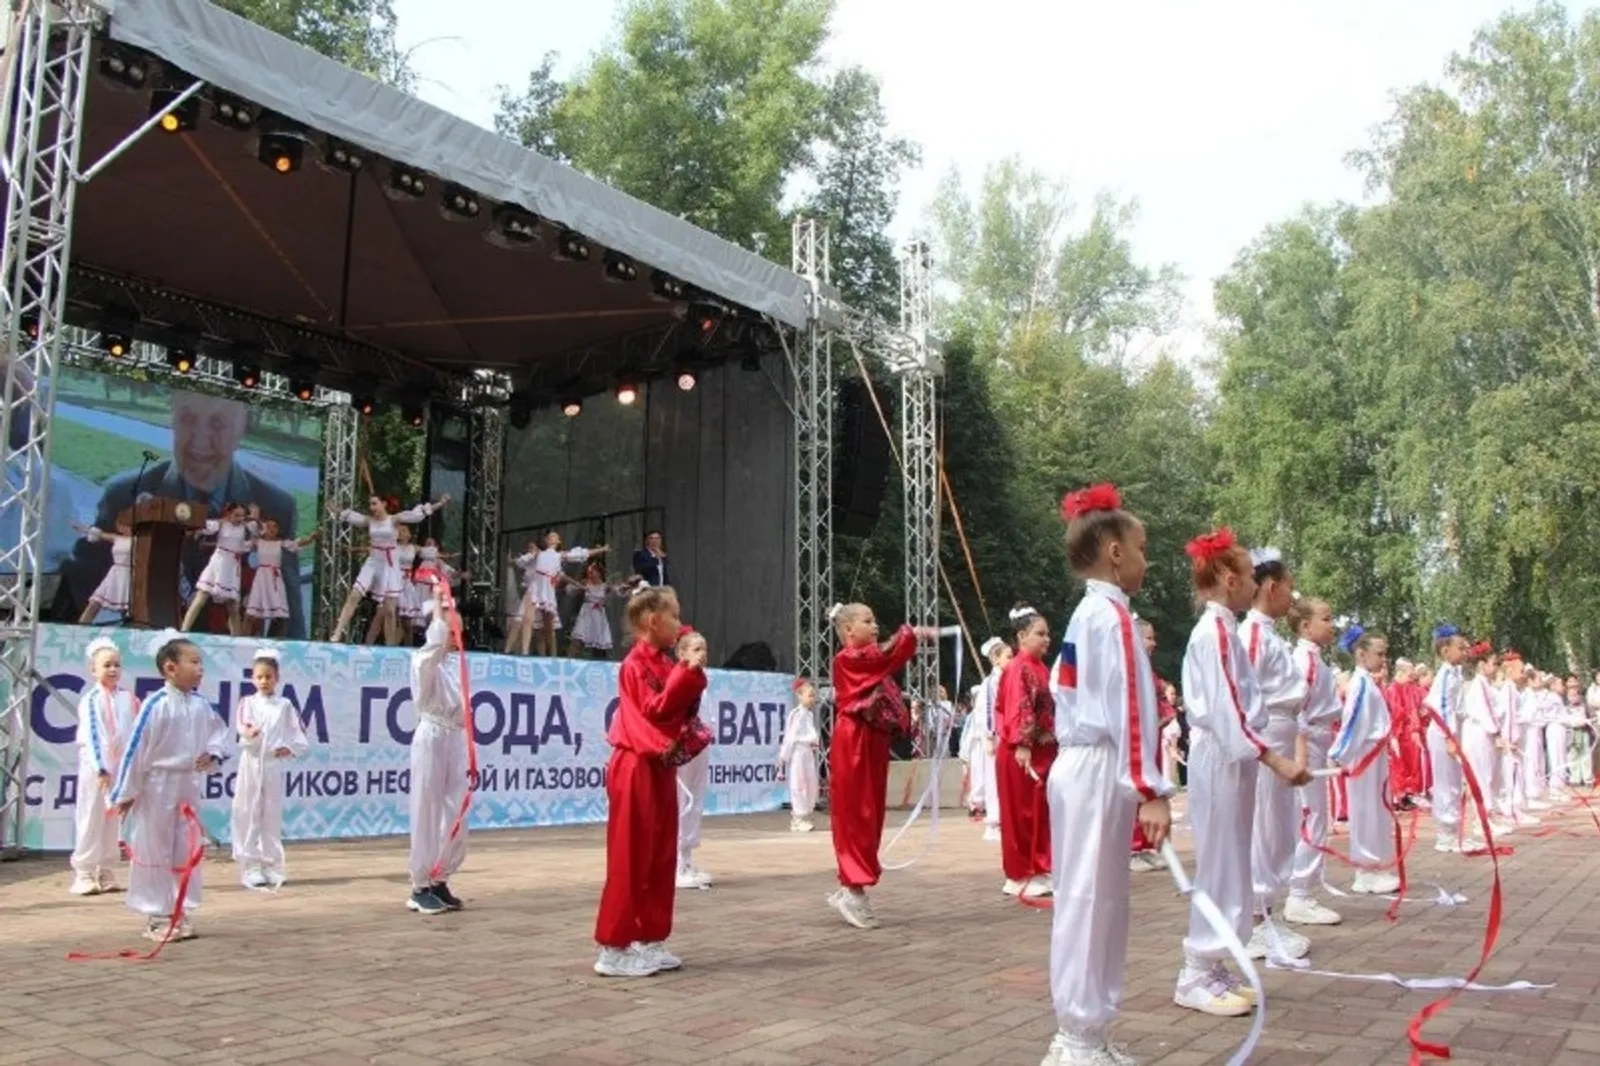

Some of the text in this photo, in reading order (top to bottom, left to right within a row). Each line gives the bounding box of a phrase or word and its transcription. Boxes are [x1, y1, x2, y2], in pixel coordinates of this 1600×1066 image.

[31, 673, 86, 744] С
[359, 686, 582, 756] ГООДА,
[24, 775, 45, 806] С
[504, 768, 520, 791] И
